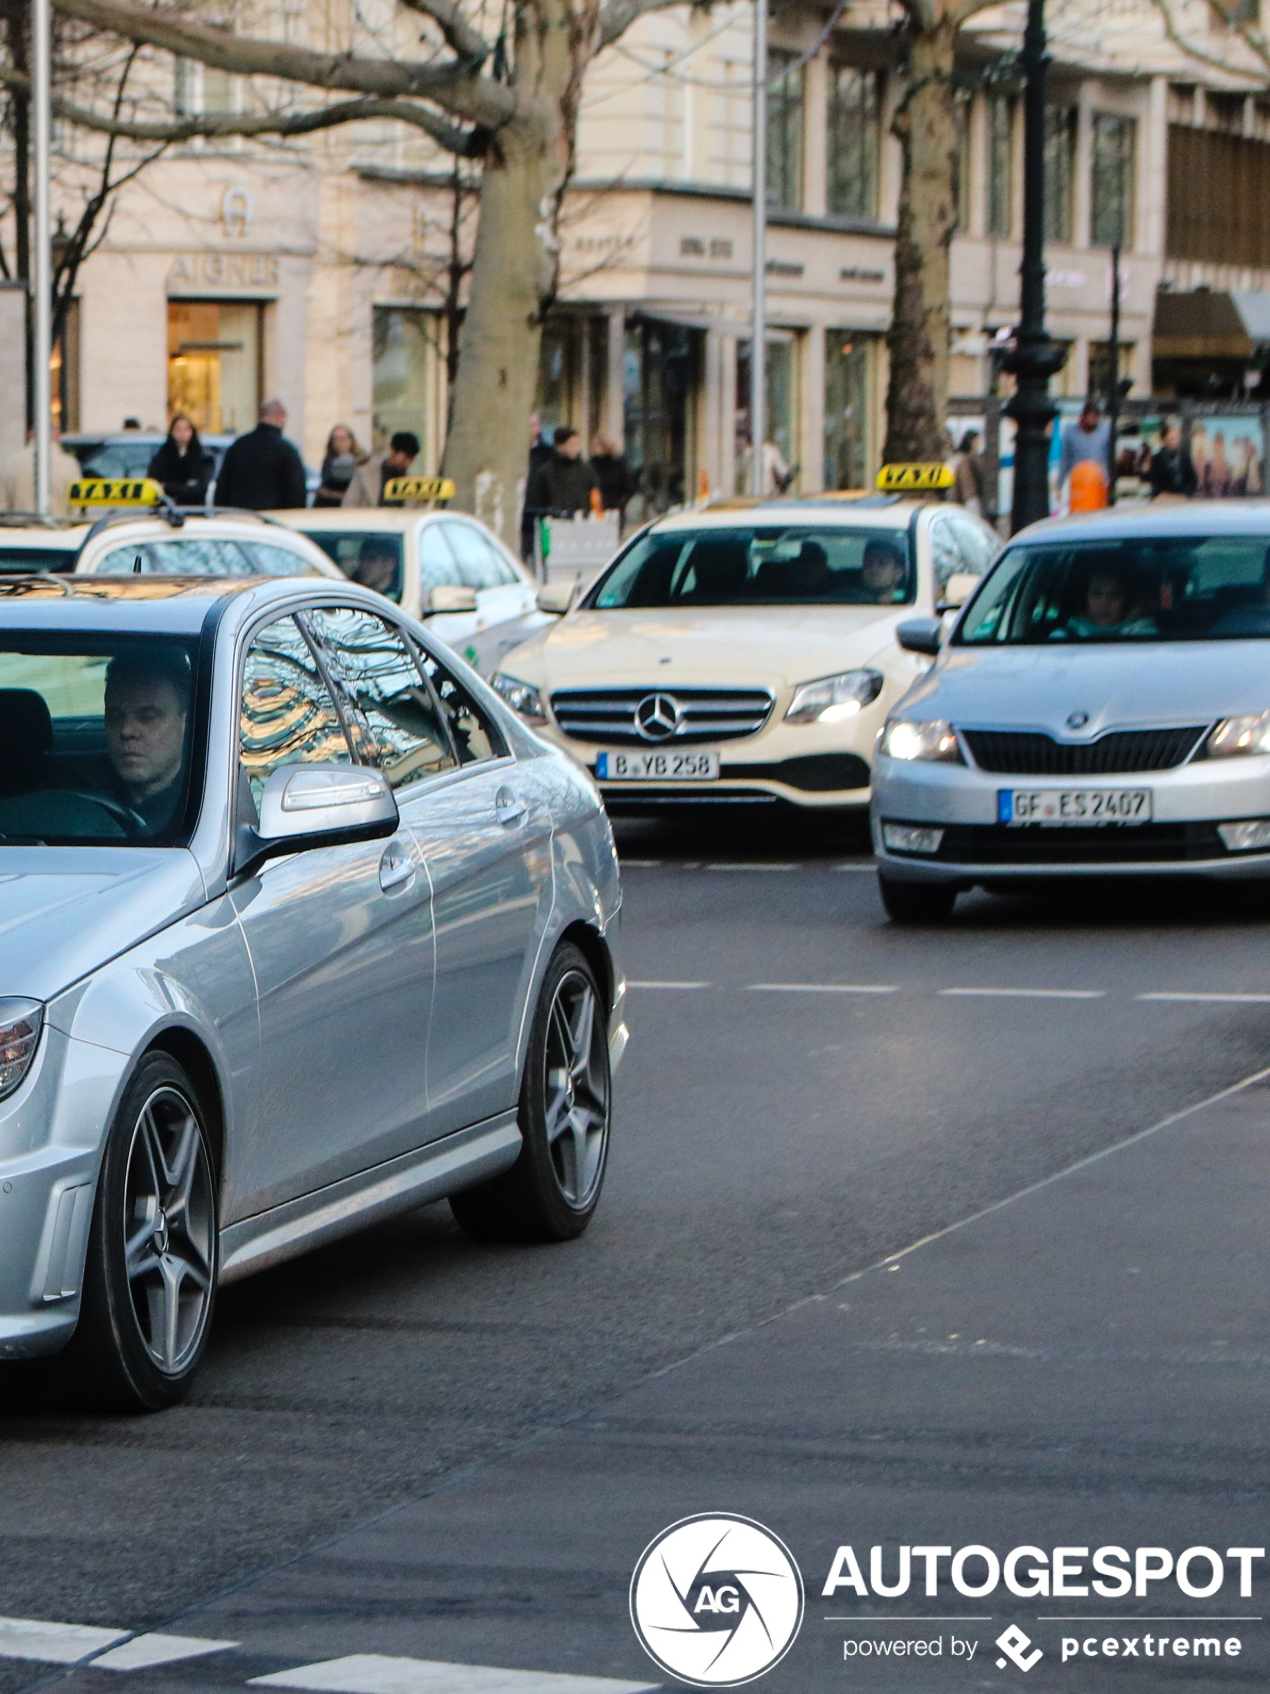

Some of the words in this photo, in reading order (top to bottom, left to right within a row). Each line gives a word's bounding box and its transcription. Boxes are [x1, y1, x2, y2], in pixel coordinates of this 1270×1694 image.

[169, 253, 280, 284] AIGNER
[884, 467, 943, 484] TAXI
[70, 482, 144, 499] TAXI
[390, 481, 443, 496] TAXI
[616, 754, 628, 775] B
[642, 754, 667, 775] YB
[672, 754, 710, 775] 258
[1015, 793, 1041, 817] GF
[1060, 793, 1086, 816] ES
[1091, 793, 1146, 816] 2407
